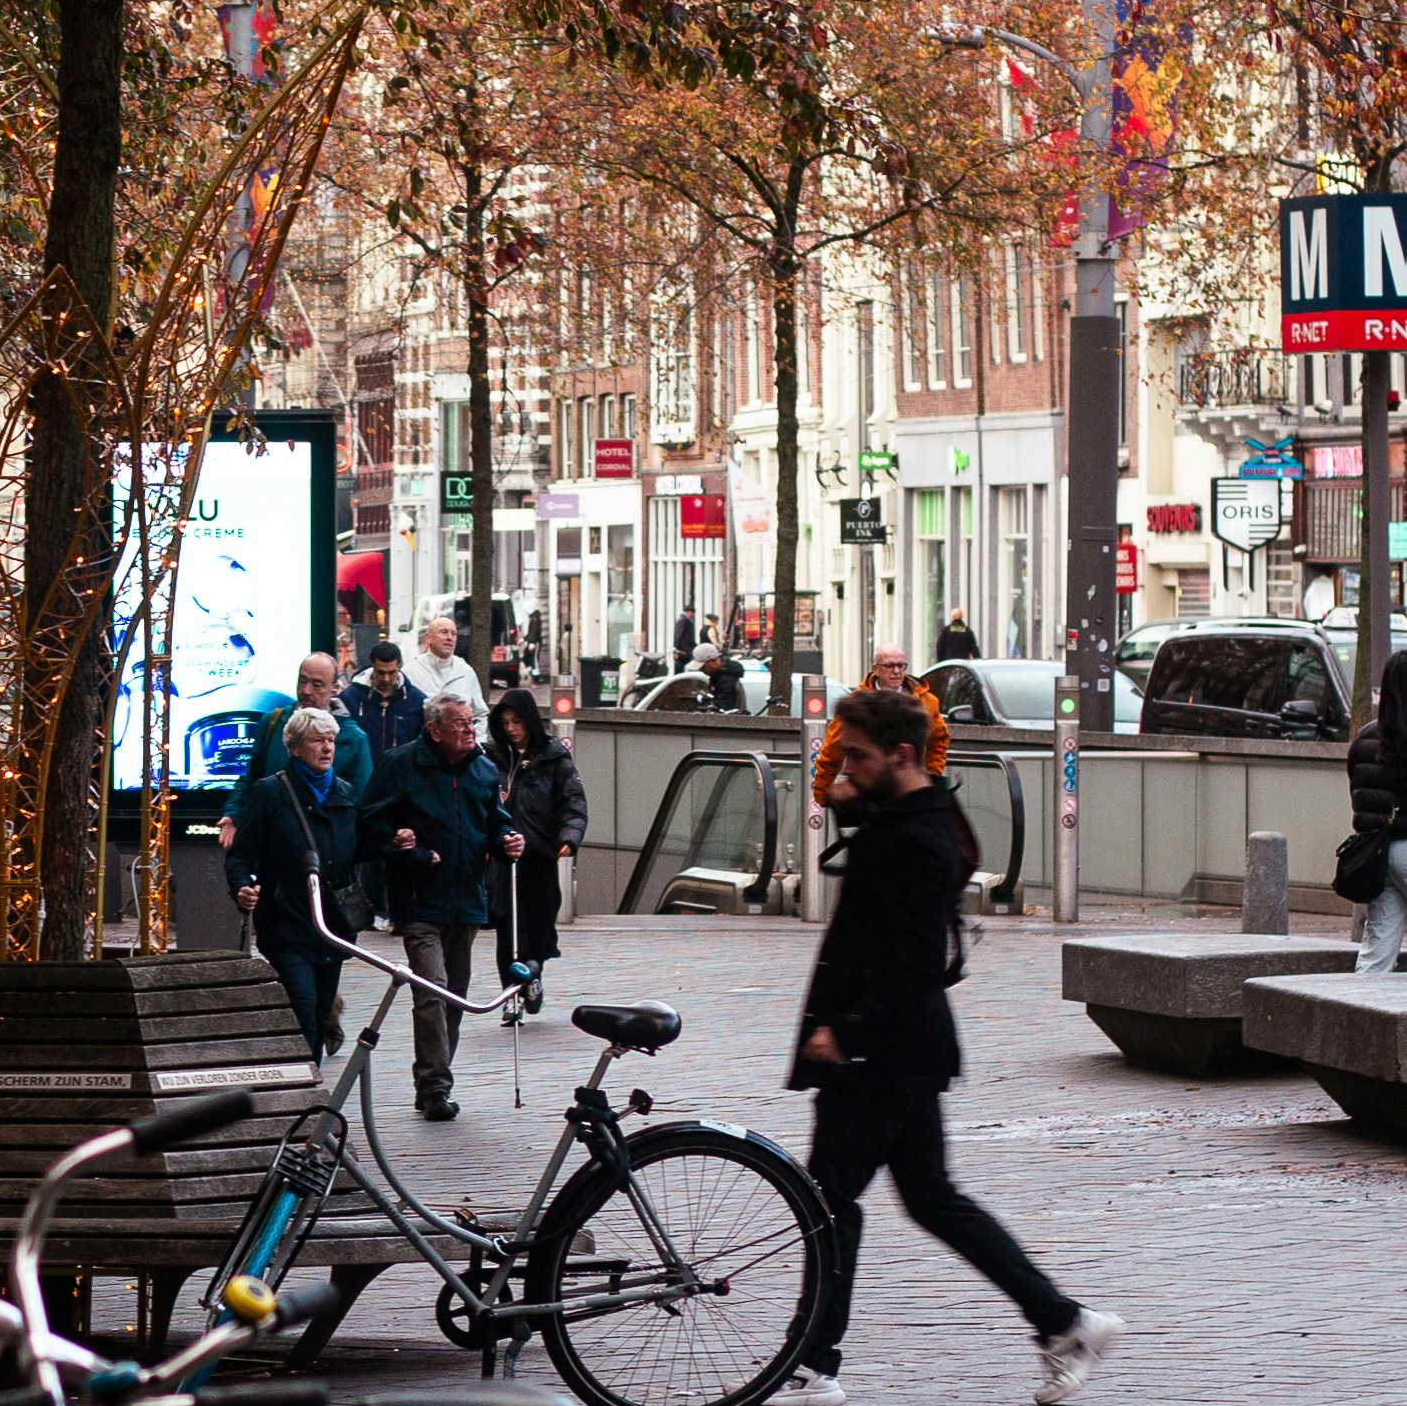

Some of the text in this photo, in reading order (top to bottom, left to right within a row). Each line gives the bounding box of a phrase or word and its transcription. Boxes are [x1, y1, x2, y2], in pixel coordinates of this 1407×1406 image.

[1289, 207, 1329, 301] M
[596, 448, 632, 456] HOTEL
[596, 463, 632, 471] CORDIAL
[1222, 505, 1274, 519] ORIS
[846, 521, 882, 529] PUERTO
[194, 528, 244, 538] CREME
[856, 529, 872, 537] INK
[54, 1076, 82, 1087] ZIJN
[85, 1076, 127, 1088] STAM,
[192, 1073, 228, 1085] VERLOREN
[228, 1071, 257, 1083] ZONDER
